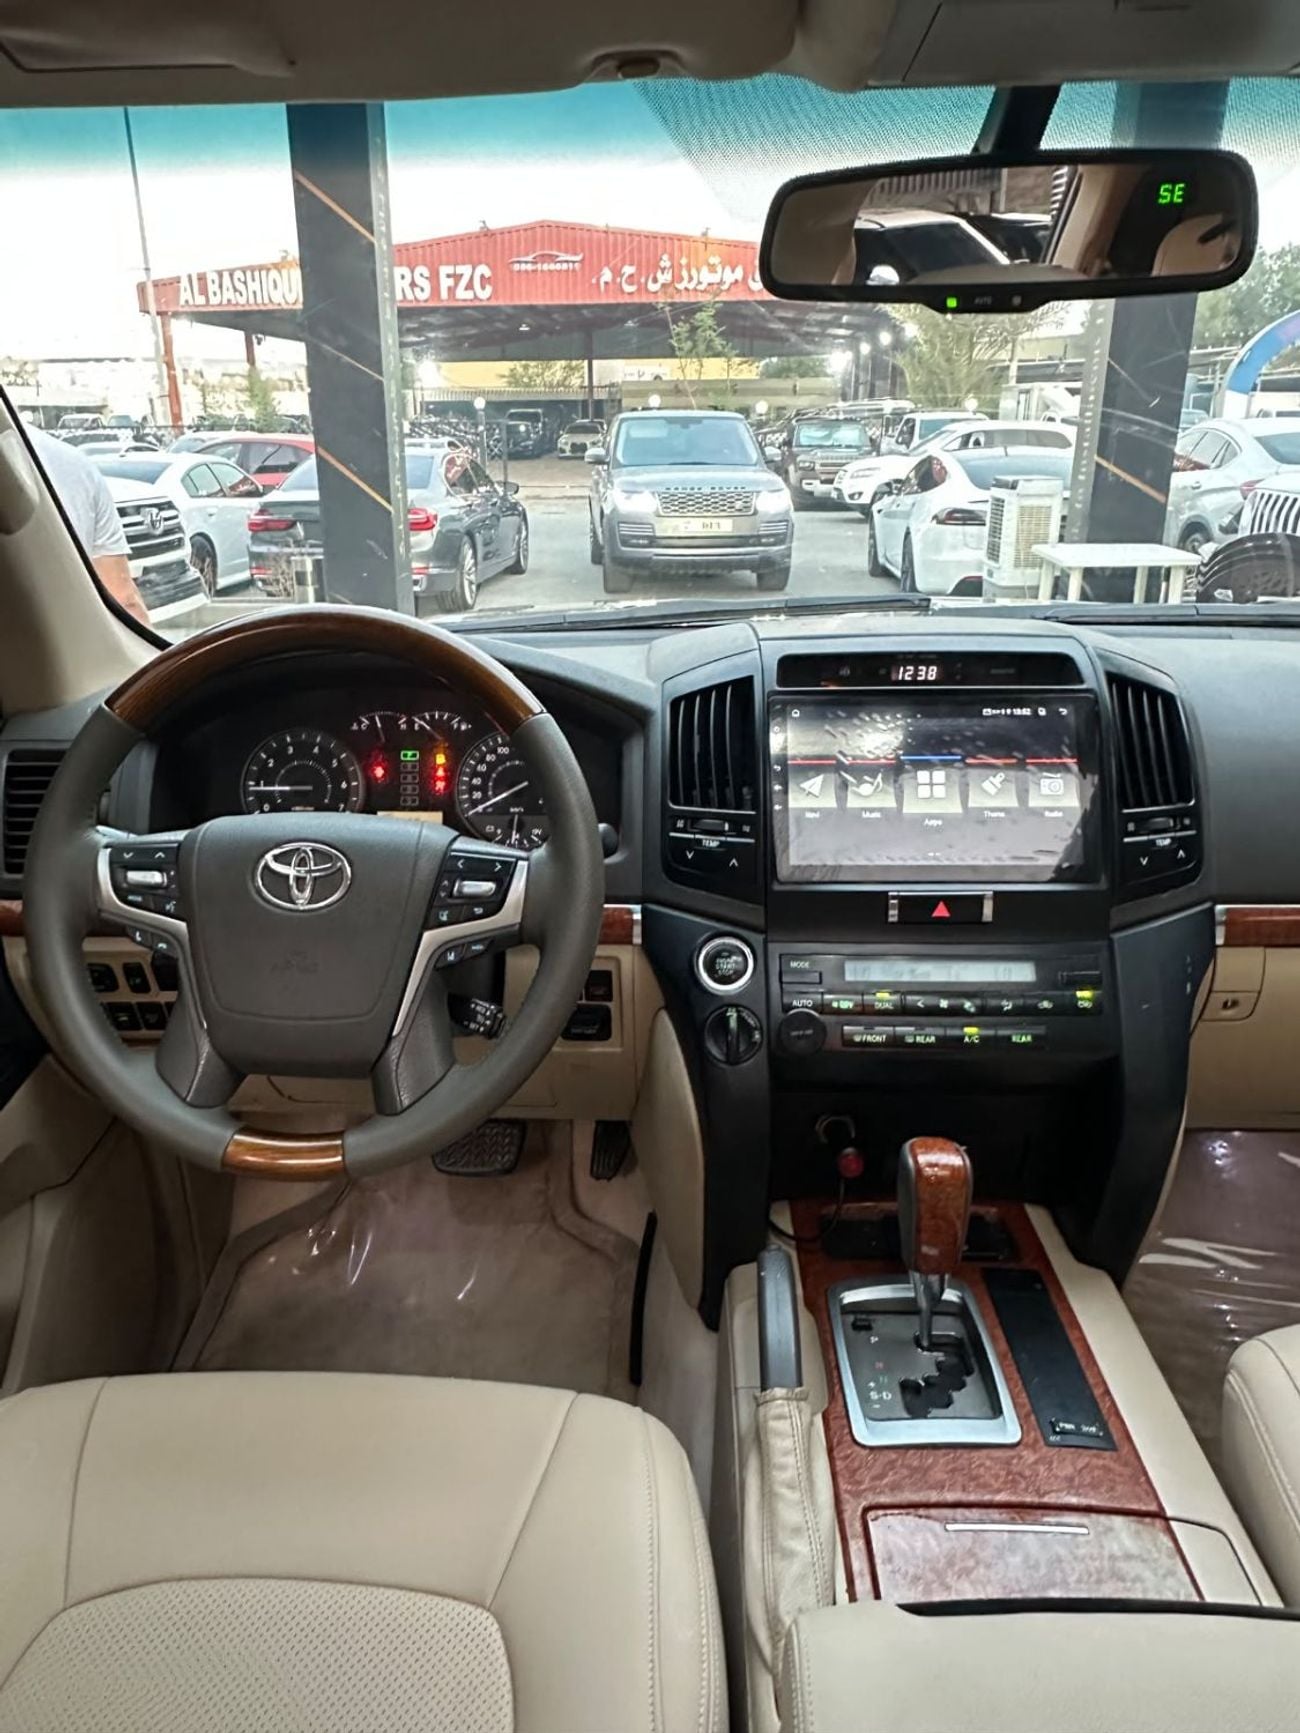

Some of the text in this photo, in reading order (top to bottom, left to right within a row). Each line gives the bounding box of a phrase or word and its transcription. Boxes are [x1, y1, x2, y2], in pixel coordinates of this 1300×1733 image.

[1158, 184, 1186, 204] SE
[180, 272, 206, 307] AL
[439, 264, 493, 301] FZC
[791, 999, 814, 1008] AUTO
[874, 1001, 895, 1010] DUAL
[862, 1034, 887, 1043] FRONT
[915, 1035, 936, 1043] REAR
[963, 1034, 980, 1043] A/C
[1011, 1034, 1032, 1042] REAR
